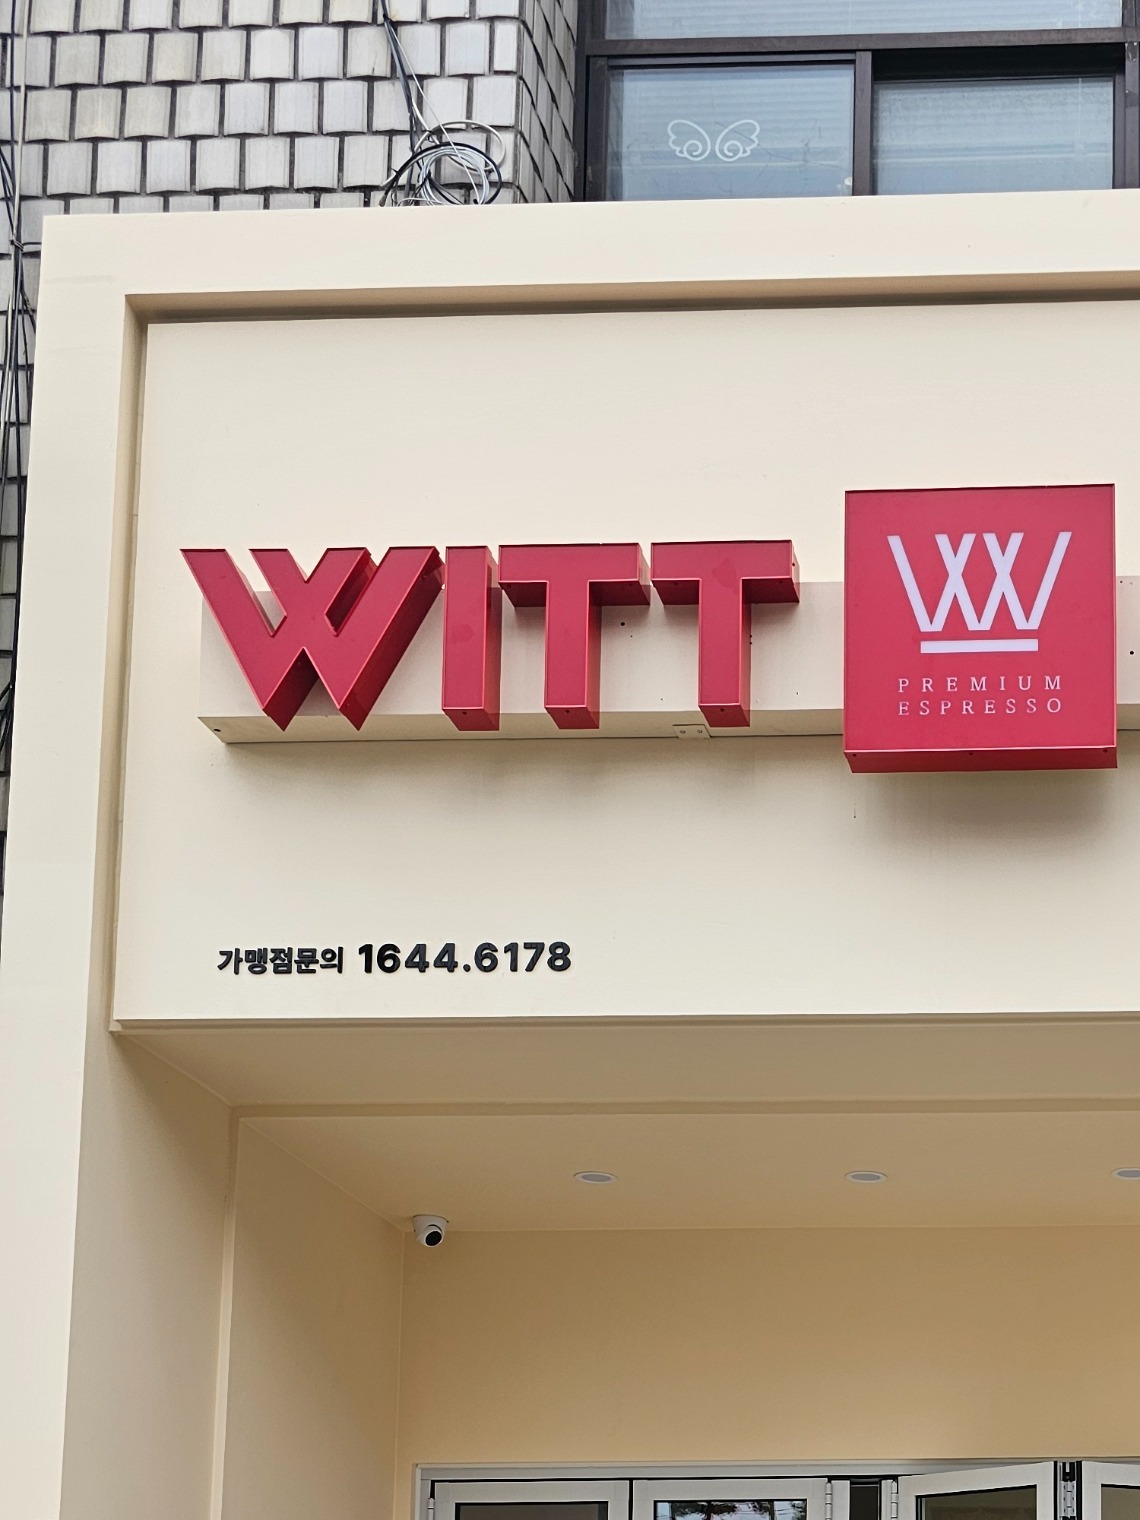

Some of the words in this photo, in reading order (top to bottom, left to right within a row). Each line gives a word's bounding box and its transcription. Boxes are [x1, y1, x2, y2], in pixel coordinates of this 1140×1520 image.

[180, 540, 800, 731] WITT
[898, 675, 1061, 693] PREMIUM
[898, 697, 1061, 715] ESPRESSO
[217, 945, 343, 975] 가맹점문의
[357, 940, 572, 974] 1644.6178
